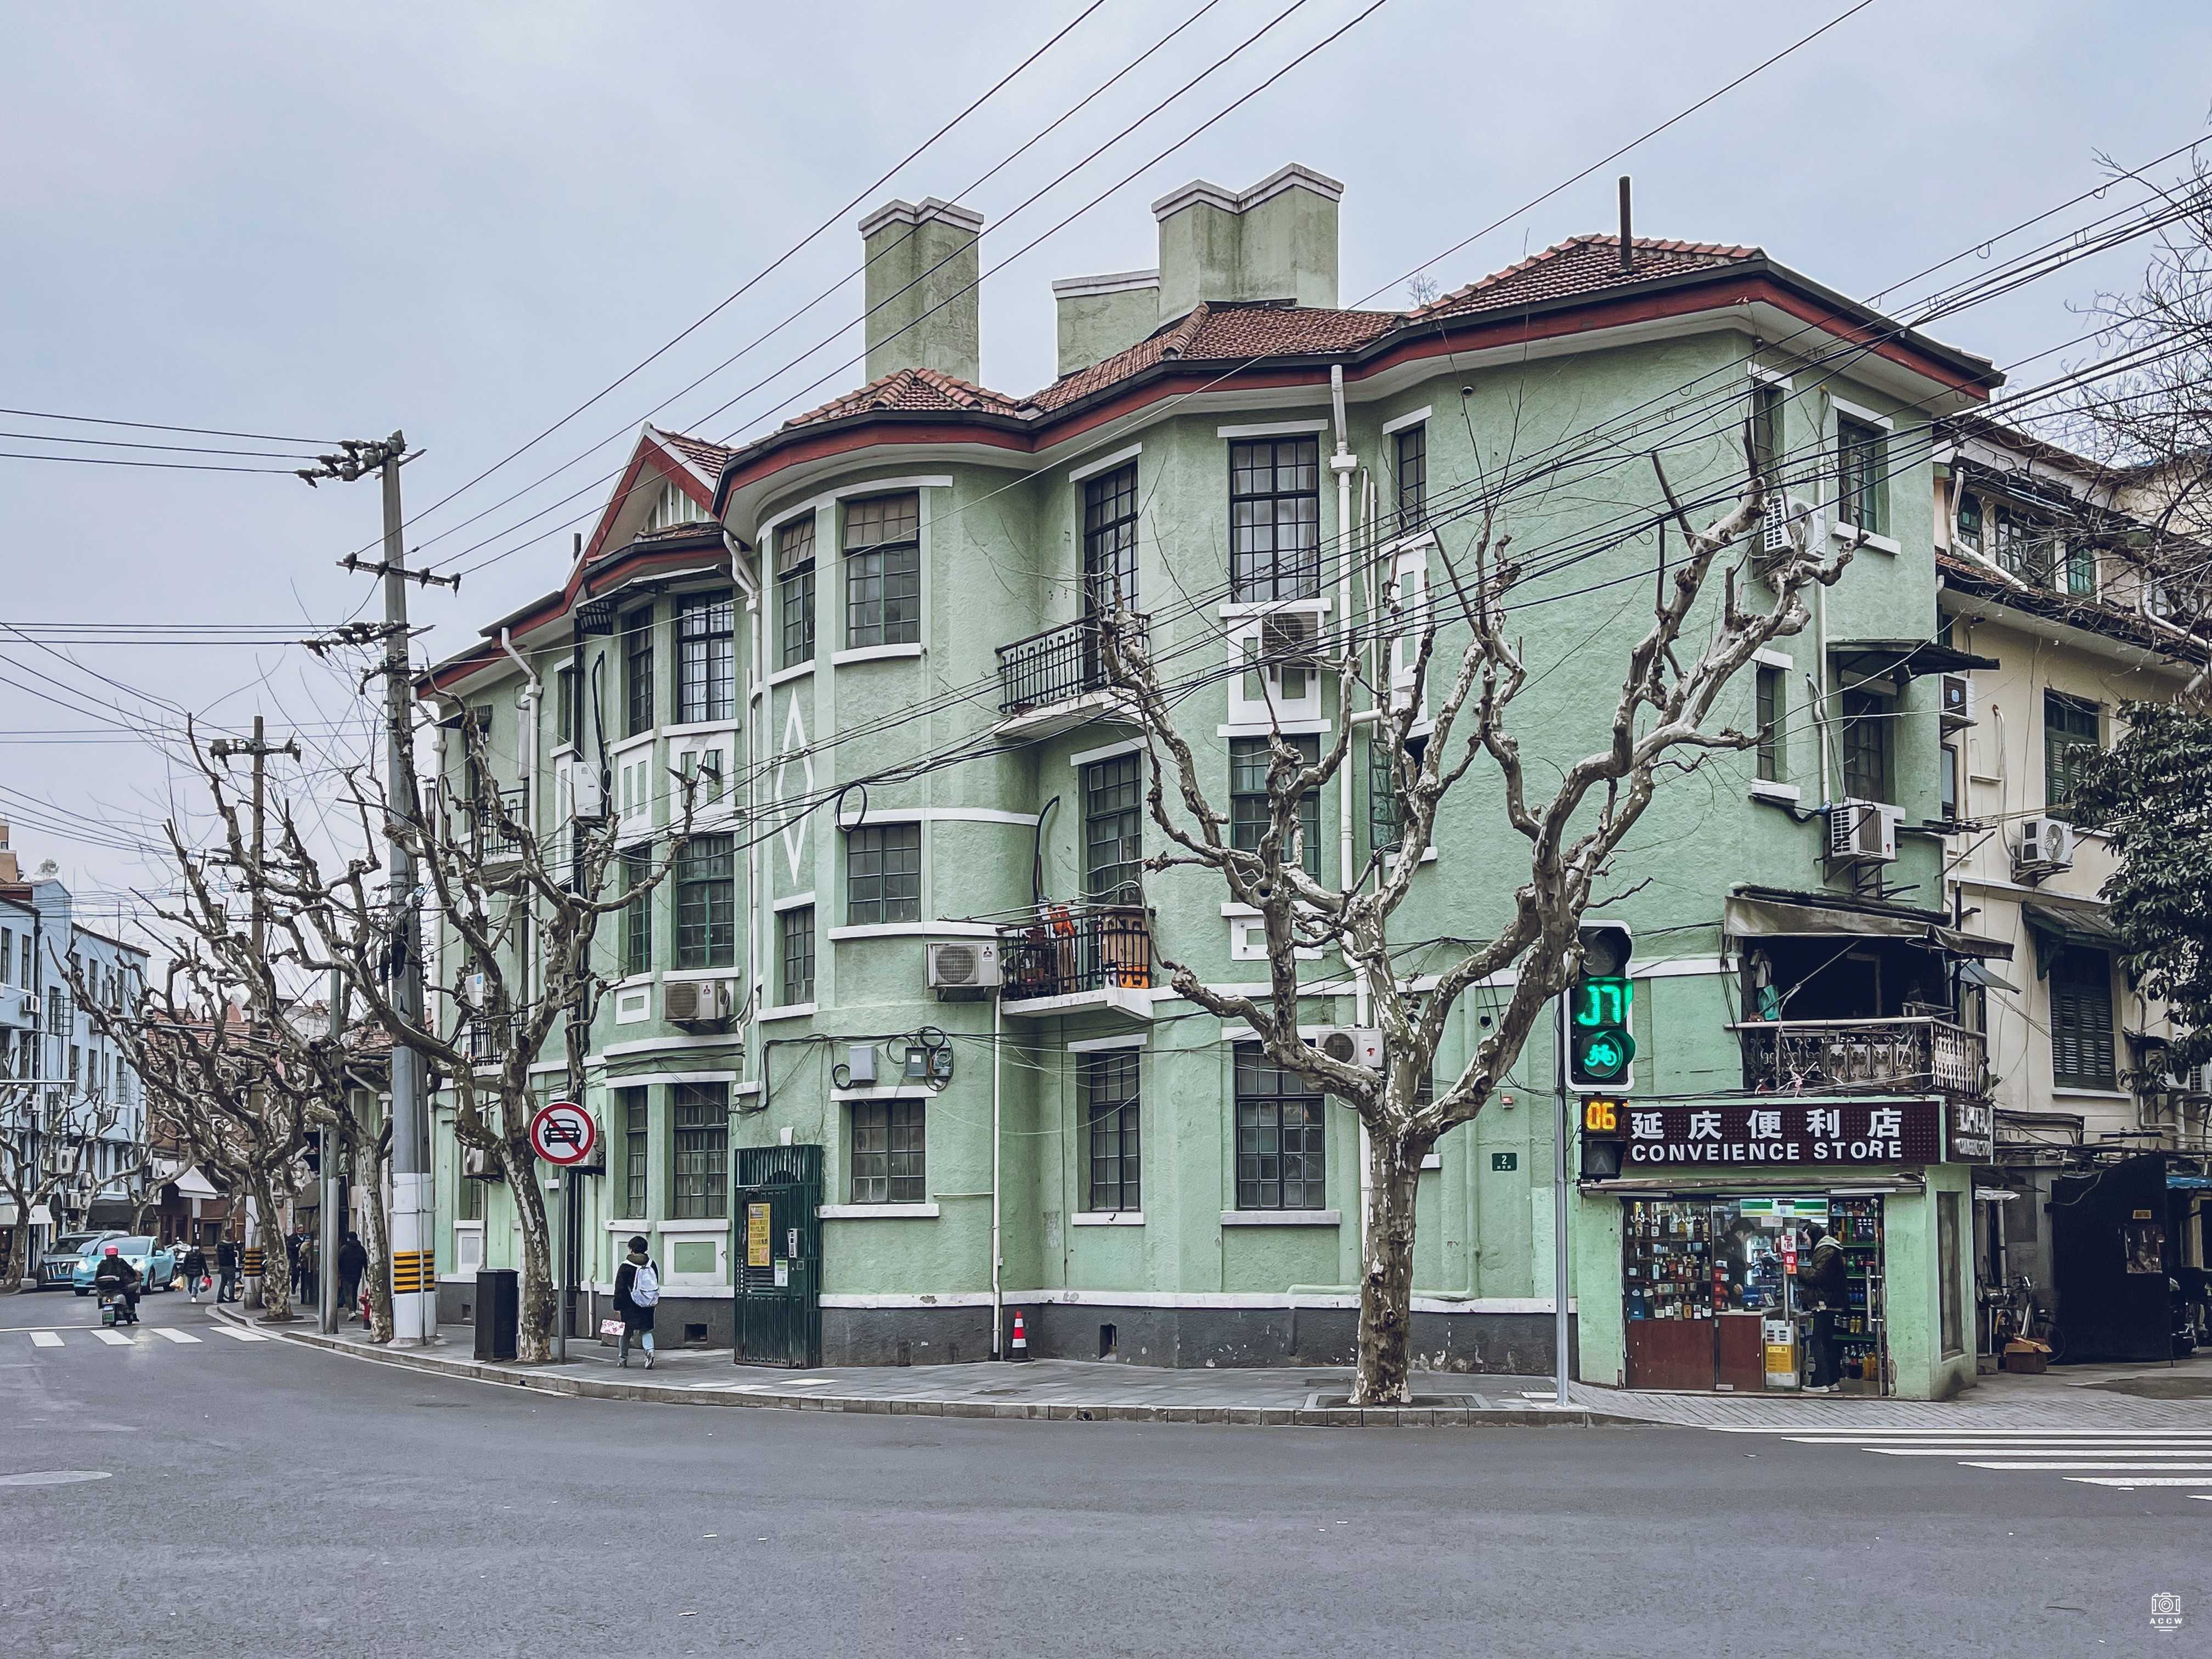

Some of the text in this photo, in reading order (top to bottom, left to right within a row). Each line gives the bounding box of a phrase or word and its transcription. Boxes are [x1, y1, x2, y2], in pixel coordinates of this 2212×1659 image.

[1587, 1102, 1616, 1129] 06
[1630, 1108, 1902, 1139] 延庆便利店
[1502, 1155, 1507, 1165] 2
[1632, 1140, 1902, 1161] CONVEIENCE STORE
